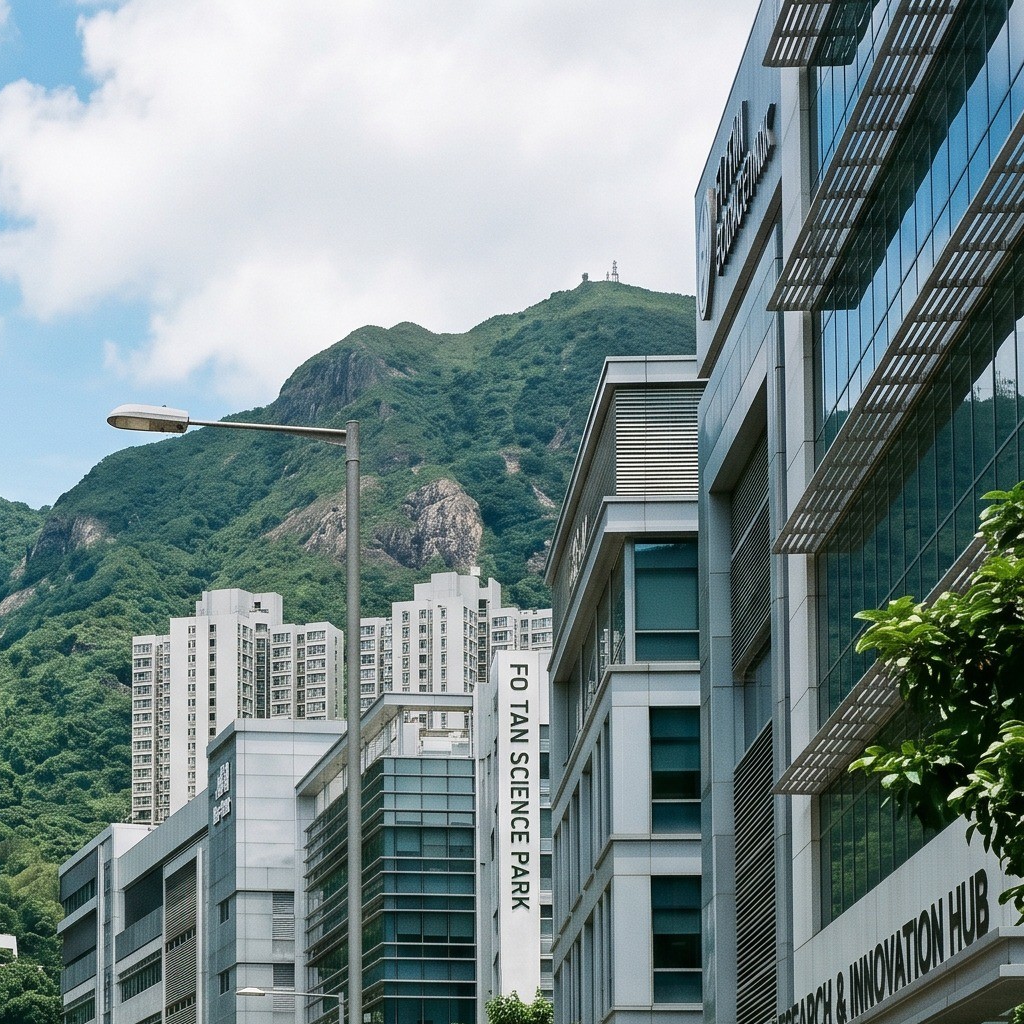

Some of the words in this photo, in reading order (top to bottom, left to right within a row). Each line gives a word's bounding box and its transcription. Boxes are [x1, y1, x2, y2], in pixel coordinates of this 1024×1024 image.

[509, 664, 529, 691] FO
[510, 700, 529, 743] TAN
[510, 752, 530, 844] SCIENCE
[511, 852, 530, 911] PARK
[849, 898, 944, 1020] INNOVATION
[948, 868, 990, 957] HUB
